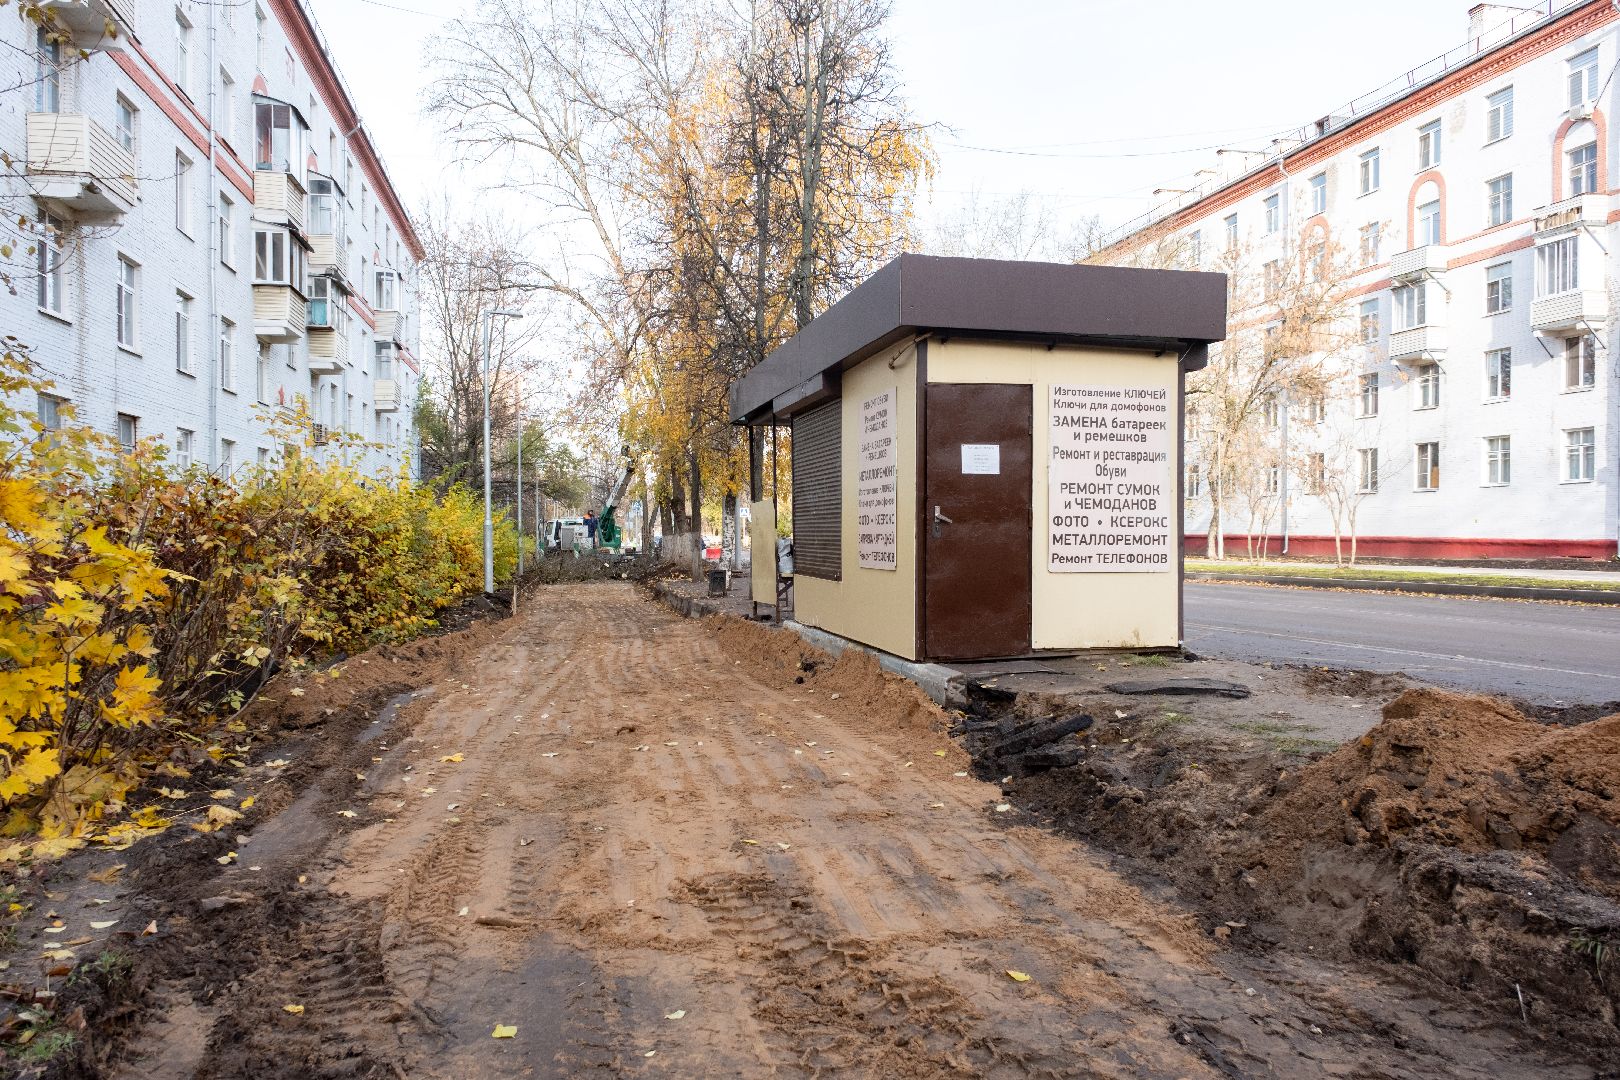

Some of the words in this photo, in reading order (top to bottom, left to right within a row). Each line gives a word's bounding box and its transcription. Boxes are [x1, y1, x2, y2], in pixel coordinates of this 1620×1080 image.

[1054, 386, 1121, 398] Изготовление
[1124, 388, 1166, 399] КЛЮЧЕЙ
[1054, 399, 1087, 409] Ключи
[1090, 402, 1108, 411] для
[1111, 402, 1166, 413] домофонов
[1053, 416, 1107, 428] ЗАМЕНА
[1111, 418, 1166, 432] батареек
[1073, 431, 1080, 440] и
[1085, 431, 1147, 443] ремешков
[1053, 446, 1091, 460] Ремонт
[1094, 450, 1100, 460] и
[1103, 450, 1166, 464] реставрация
[1095, 464, 1127, 480] Обуви
[1060, 483, 1113, 494] РЕМОНТ
[1117, 484, 1160, 495] СУМОК
[1064, 500, 1071, 510] и
[1075, 498, 1156, 512] ЧЕМОДАНОВ
[1053, 515, 1089, 528] ФОТО
[1110, 516, 1168, 528] КСЕРОКС
[1052, 534, 1168, 545] МЕТАЛЛОРЕМОНТ
[1052, 553, 1093, 563] Ремонт
[1096, 553, 1168, 564] ТЕЛЕФОНОВ
